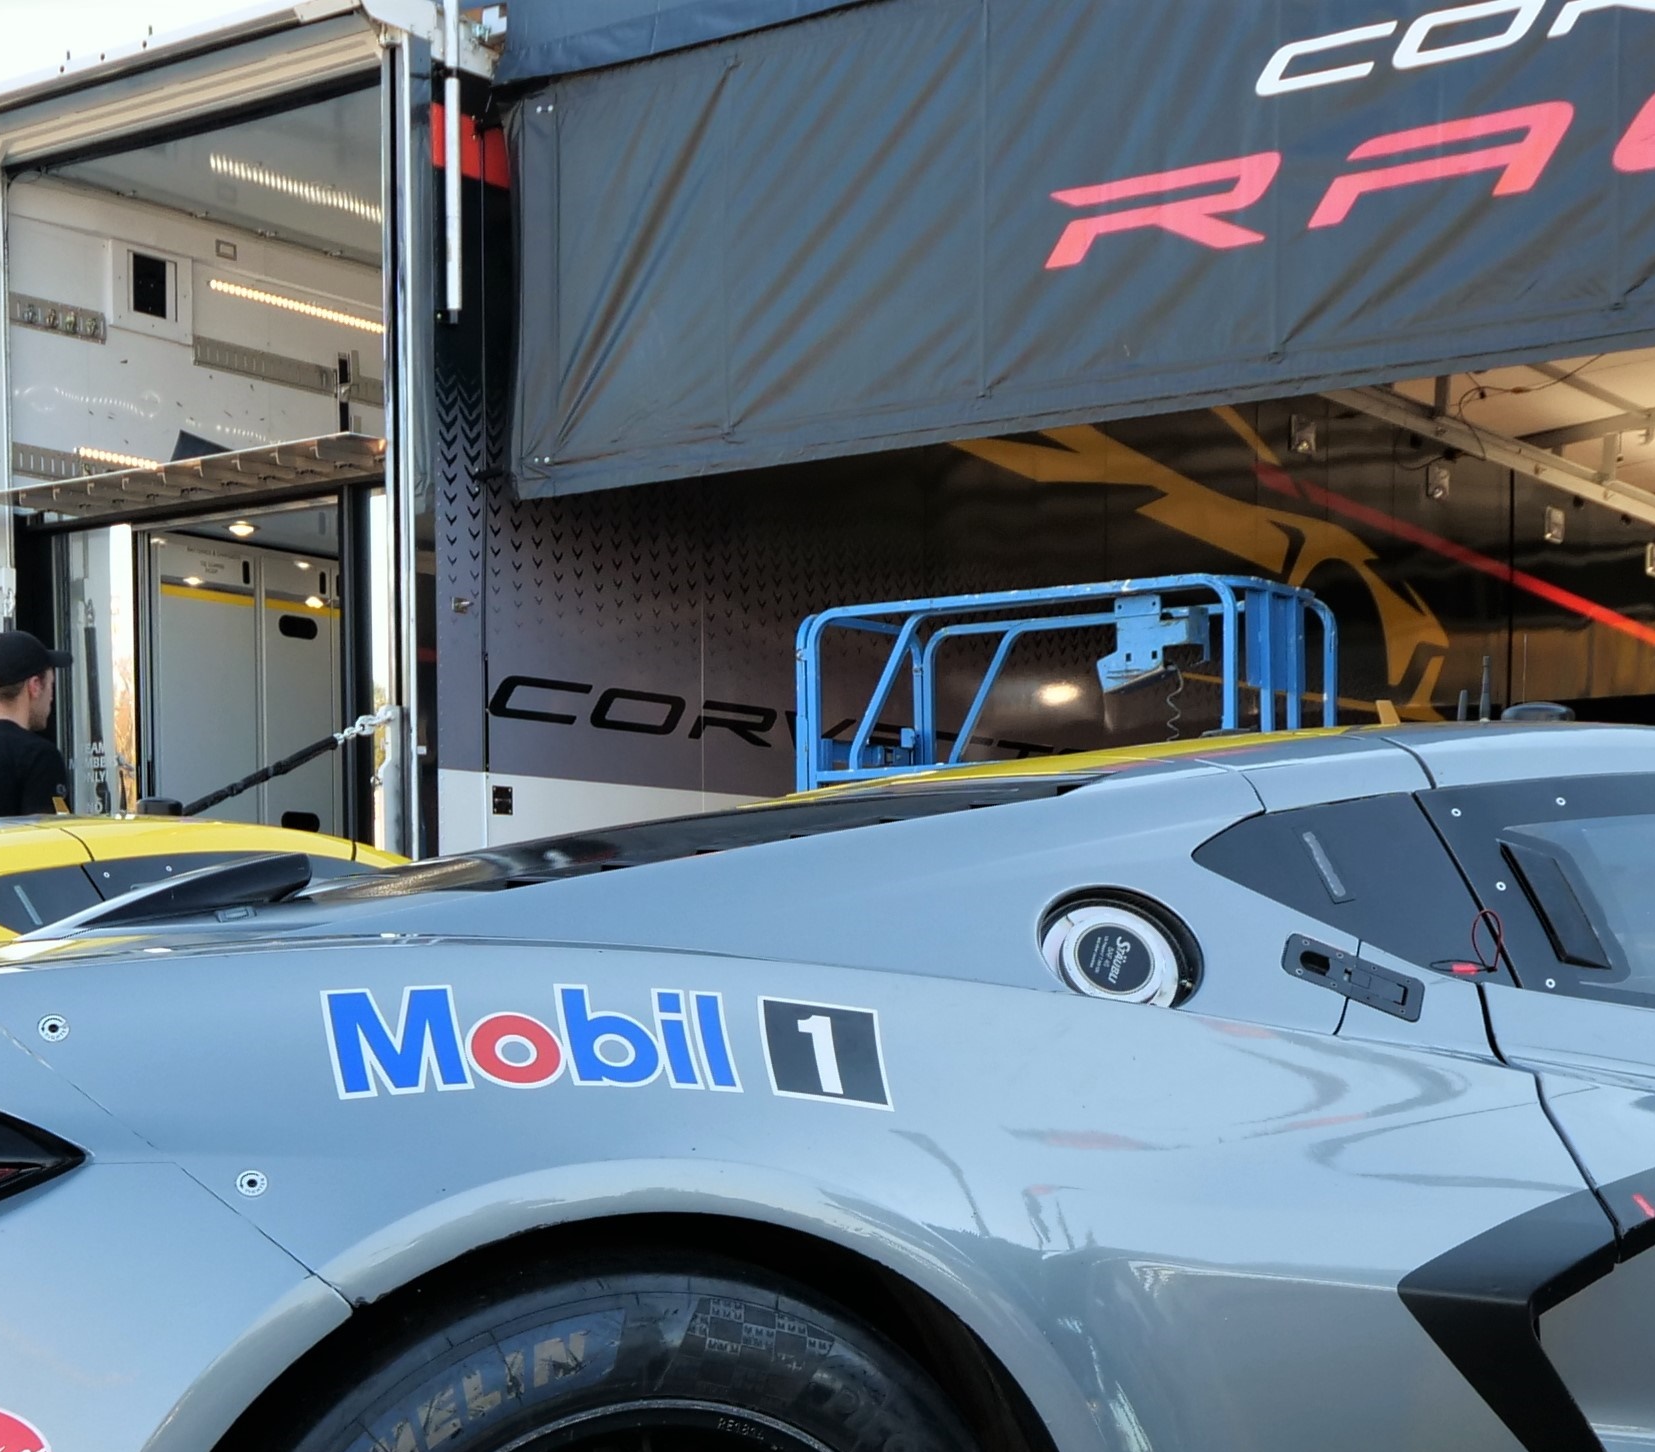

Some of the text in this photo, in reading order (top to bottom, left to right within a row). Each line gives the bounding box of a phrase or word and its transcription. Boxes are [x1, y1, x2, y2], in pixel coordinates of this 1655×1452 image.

[68, 757, 118, 770] MMBES
[320, 983, 844, 1100] Mobil 1
